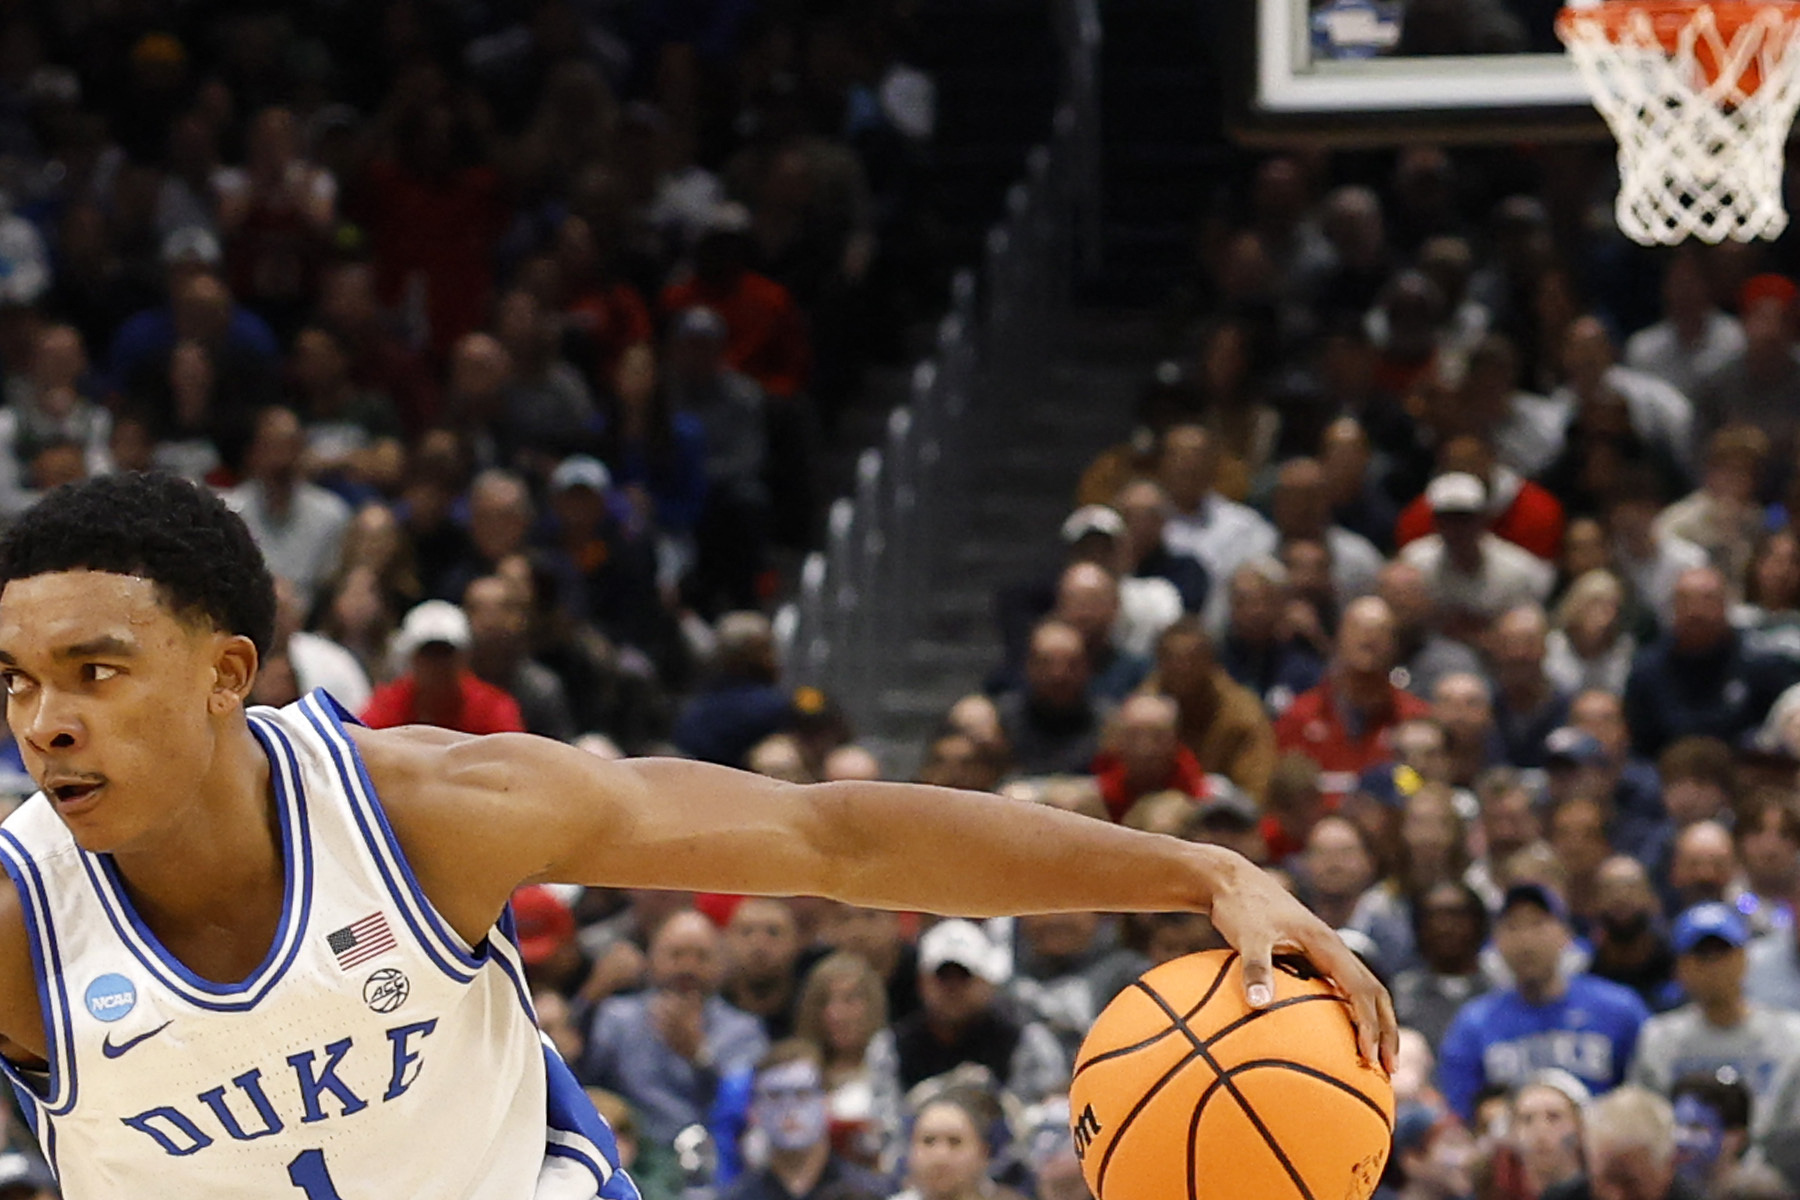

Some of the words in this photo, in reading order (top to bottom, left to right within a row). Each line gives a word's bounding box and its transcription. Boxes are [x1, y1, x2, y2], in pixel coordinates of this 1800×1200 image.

[91, 991, 133, 1012] NCAA
[369, 975, 405, 1003] ACC
[119, 1017, 439, 1156] DUKE
